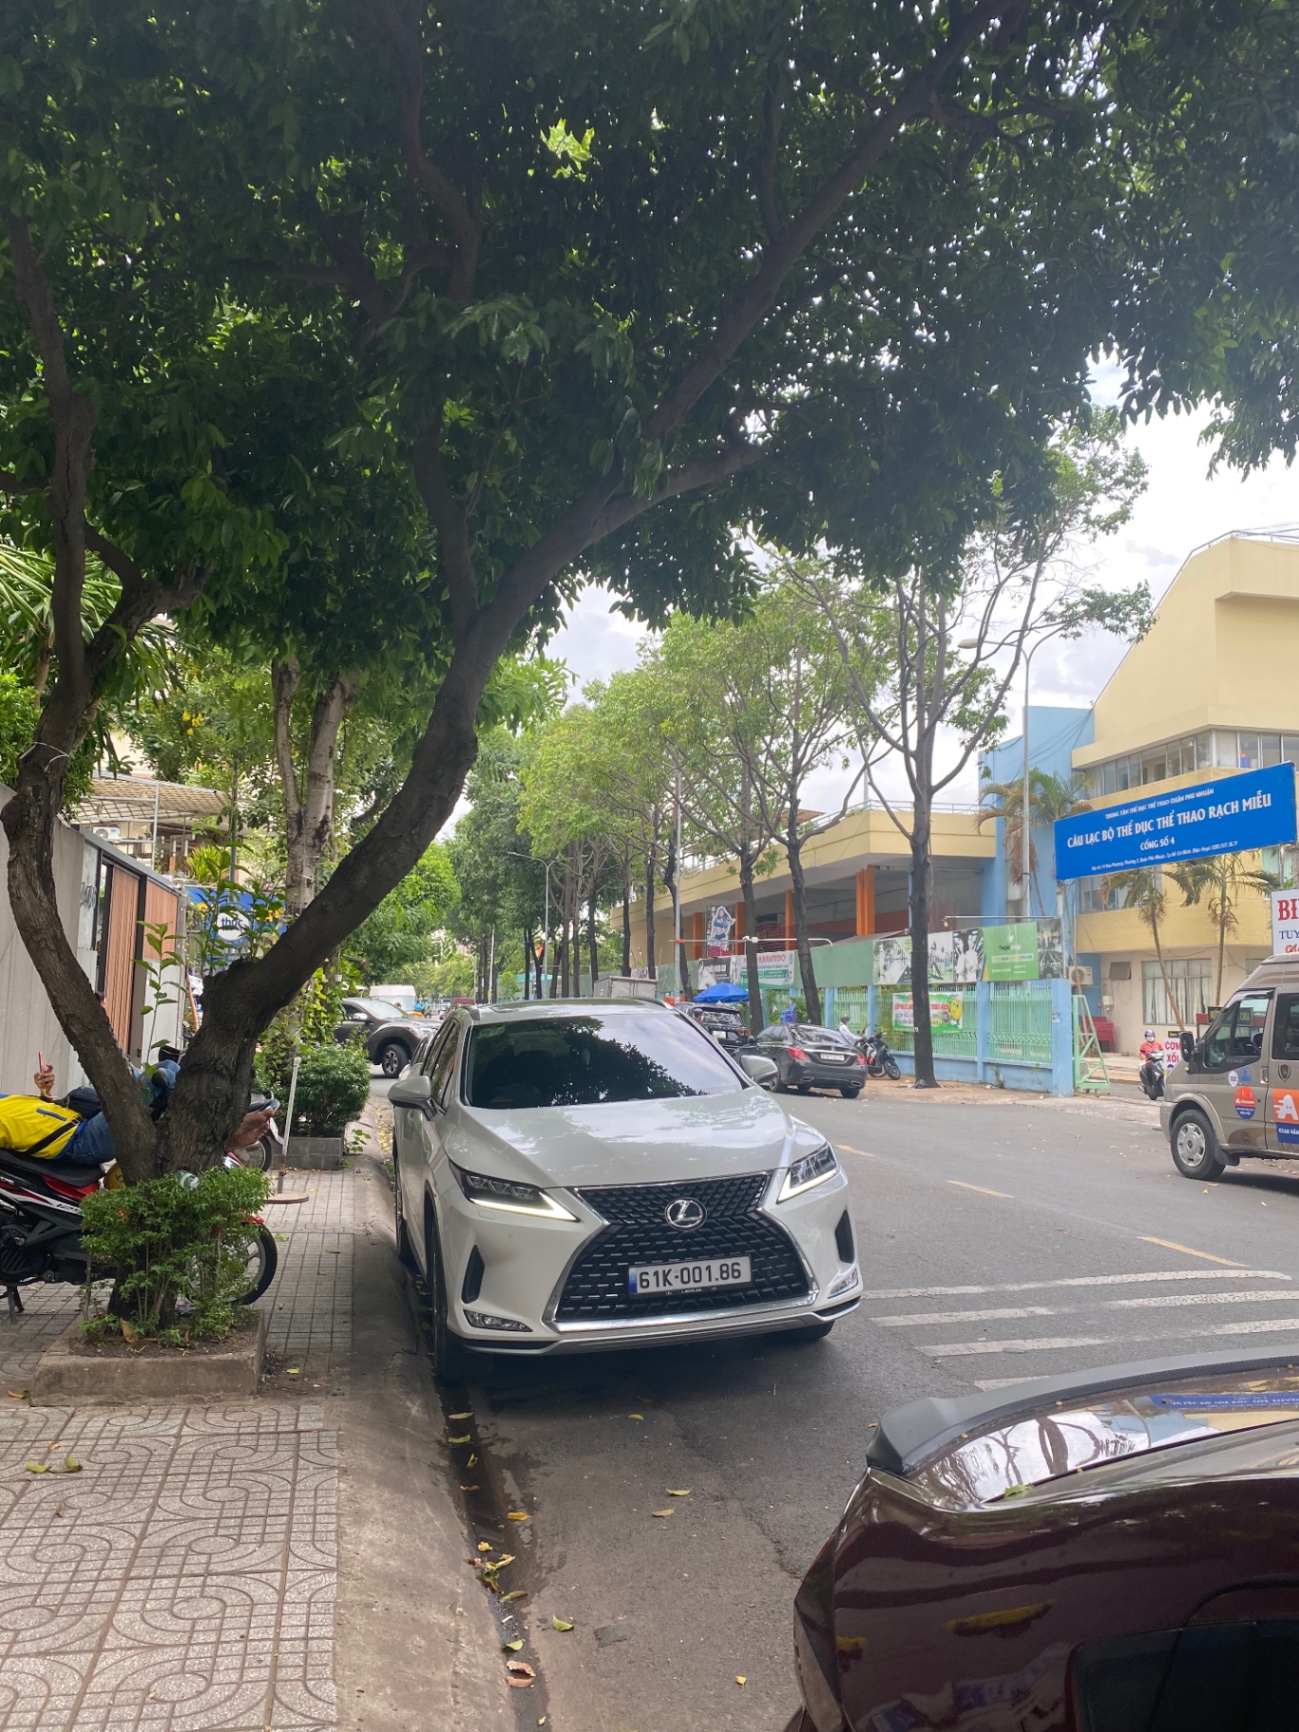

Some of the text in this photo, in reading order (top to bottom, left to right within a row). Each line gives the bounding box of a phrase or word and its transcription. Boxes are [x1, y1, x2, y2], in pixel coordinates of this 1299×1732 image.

[1085, 831, 1100, 846] LẠC
[1102, 826, 1115, 841] BỘ
[1116, 819, 1133, 838] THỂ
[1135, 819, 1154, 835] DỤC
[1156, 809, 1175, 829] THỂ
[1177, 808, 1205, 825] THAO
[1208, 800, 1239, 819] RẠCH
[1242, 790, 1272, 812] MIỄU
[1160, 835, 1169, 847] SỐ
[1170, 836, 1175, 845] 4
[1277, 898, 1299, 921] BI
